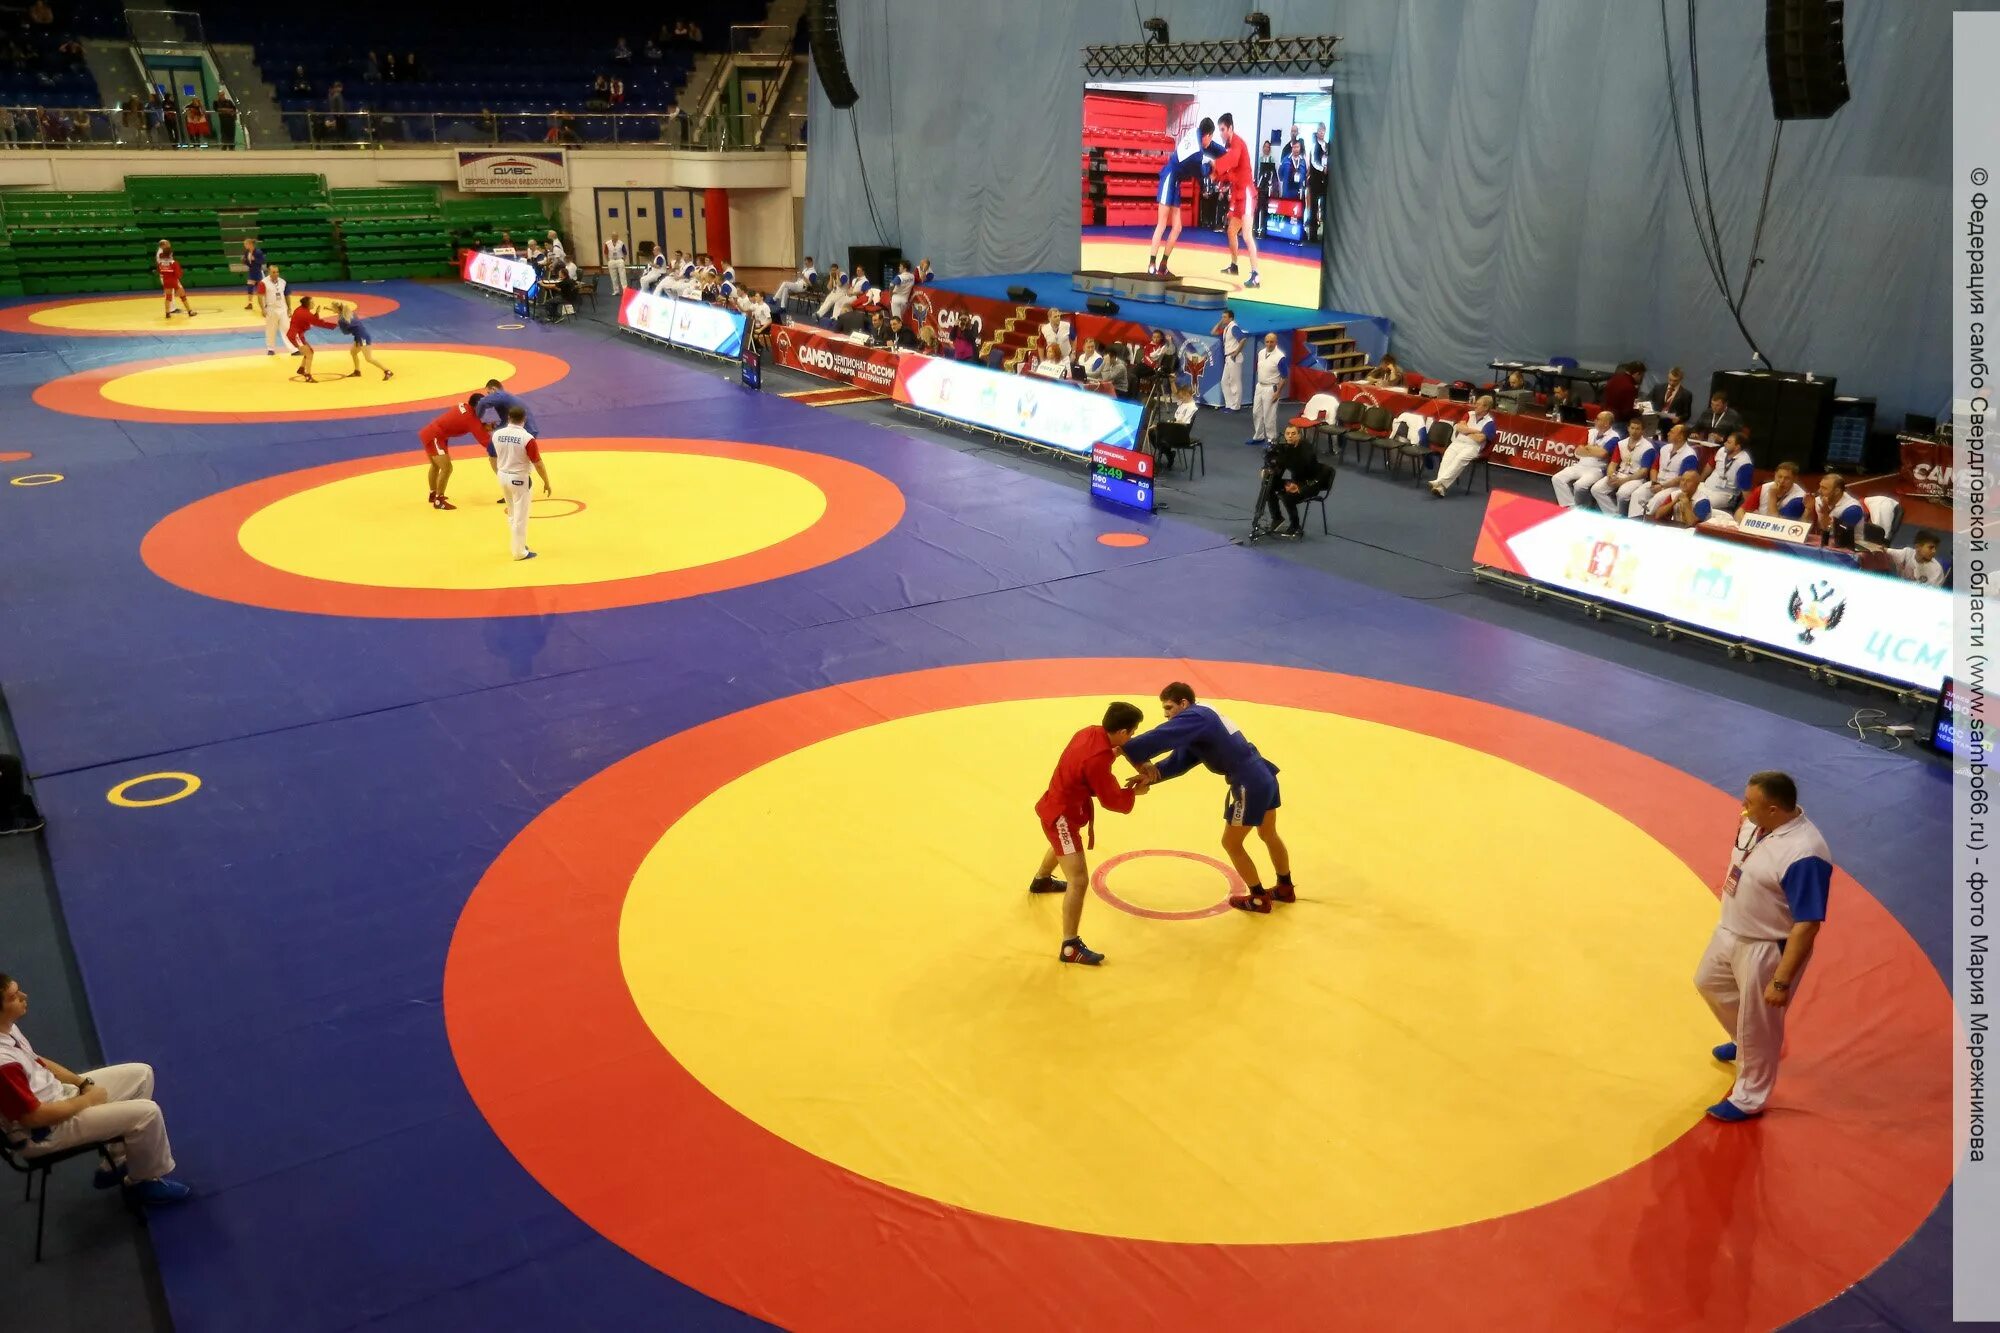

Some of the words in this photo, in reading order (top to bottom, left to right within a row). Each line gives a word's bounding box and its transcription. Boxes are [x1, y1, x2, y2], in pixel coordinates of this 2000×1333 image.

[938, 309, 982, 333] САО
[799, 345, 833, 370] САМБО
[834, 354, 867, 370] ЧЕМПИОНАТ
[867, 362, 896, 379] РОССИИ
[498, 436, 521, 444] REFEREE
[1093, 455, 1107, 465] МОС
[1138, 461, 1146, 473] 0
[1096, 464, 1123, 480] 2:49
[1092, 474, 1107, 483] ПФО
[1137, 489, 1145, 502] 0
[1744, 519, 1771, 530] КОВЕР
[1863, 628, 1948, 671] ЦСМ
[1938, 722, 1963, 739] МОС
